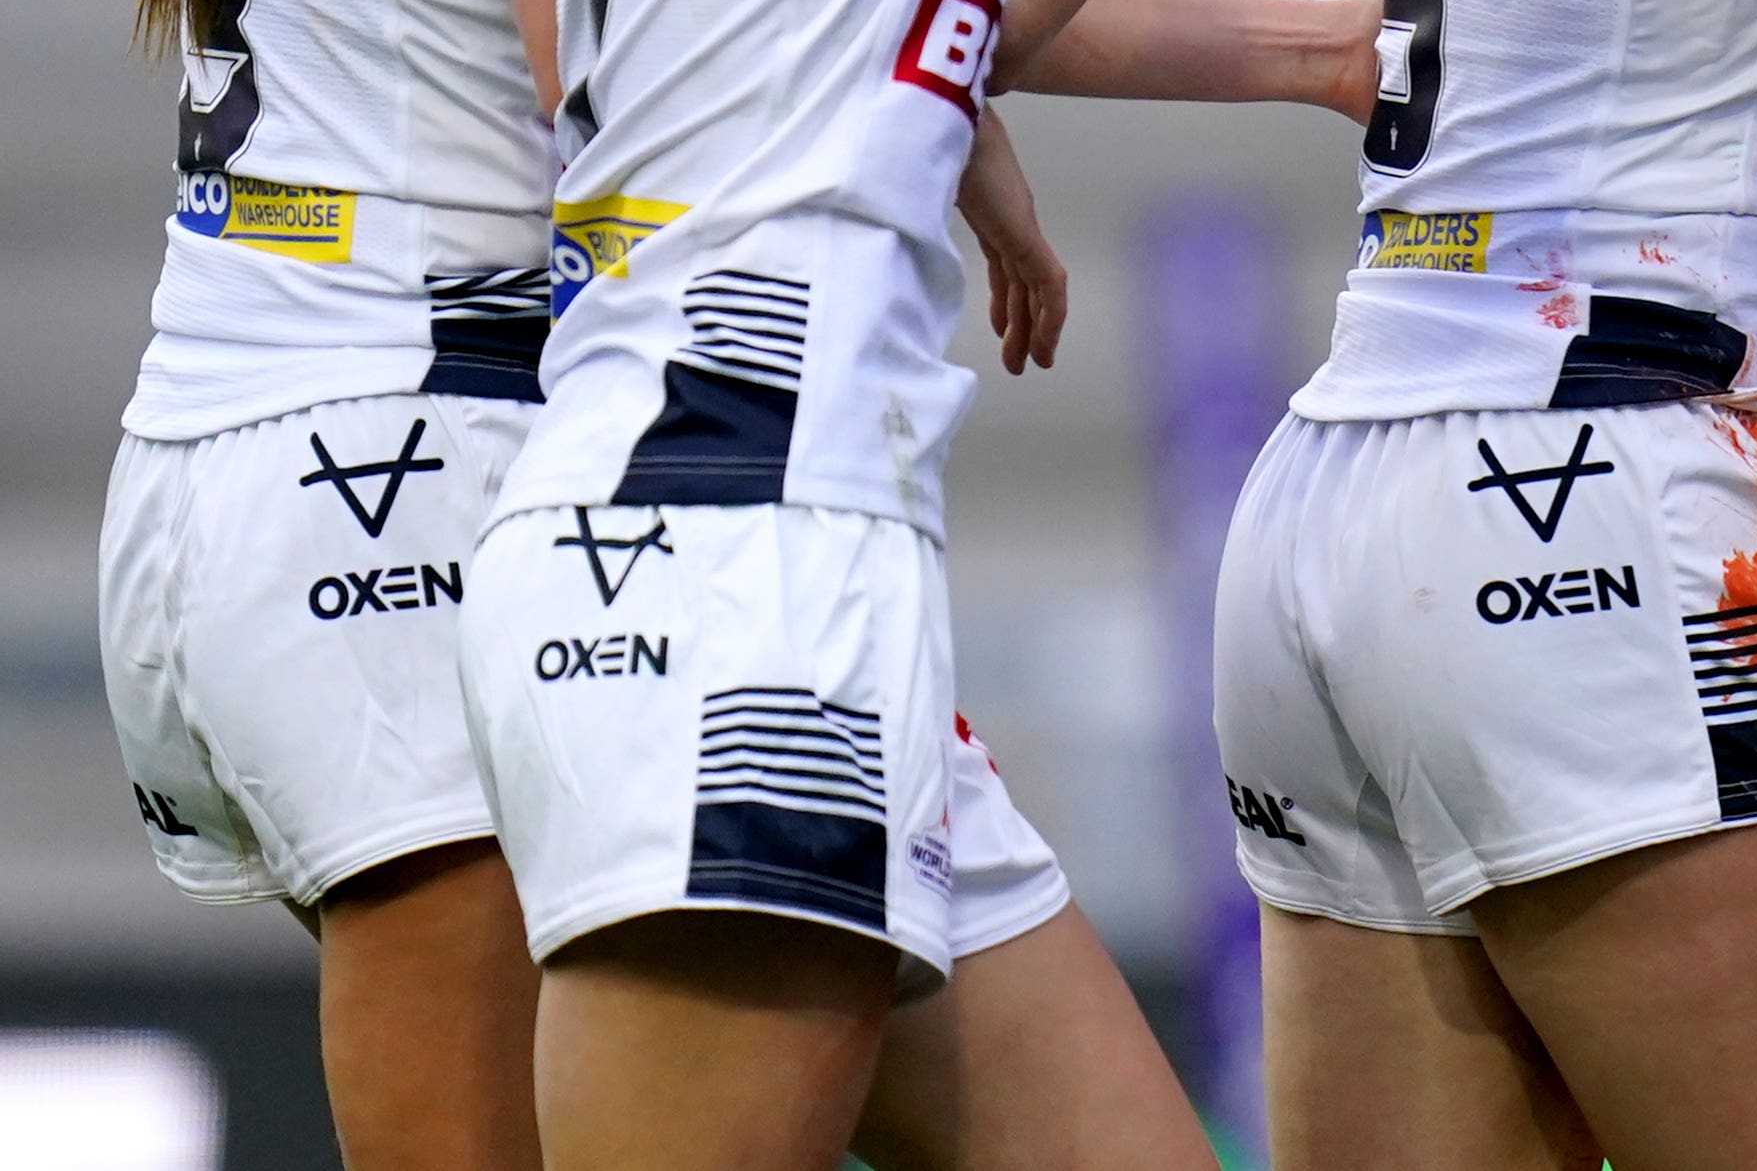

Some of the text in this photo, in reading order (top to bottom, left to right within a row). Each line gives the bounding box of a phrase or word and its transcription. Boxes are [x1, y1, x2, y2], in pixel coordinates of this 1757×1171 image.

[235, 202, 341, 228] WAREHOUSE
[309, 562, 463, 619] OXEN
[1476, 565, 1641, 625] OXEN
[535, 635, 669, 681] OXEN
